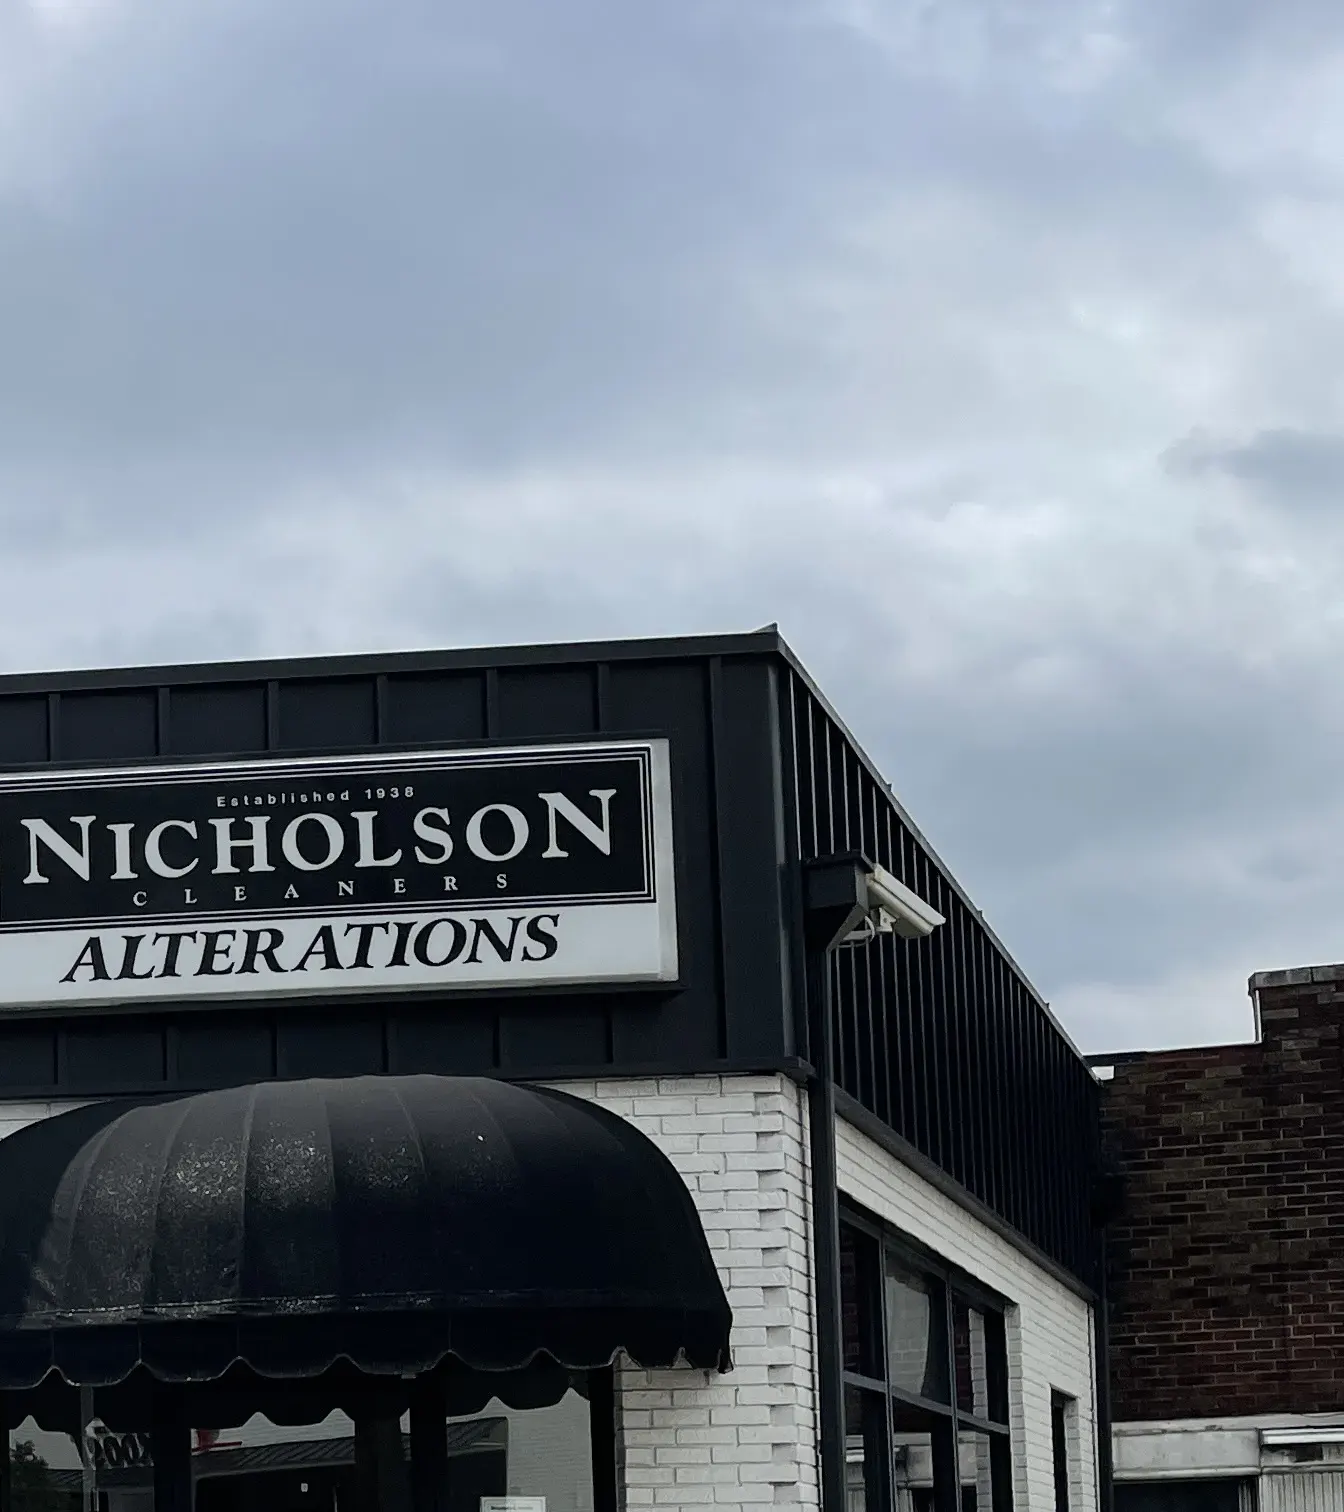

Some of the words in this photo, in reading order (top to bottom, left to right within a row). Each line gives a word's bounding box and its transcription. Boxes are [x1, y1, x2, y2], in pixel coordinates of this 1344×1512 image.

[216, 790, 350, 808] Established
[364, 786, 414, 800] 1938
[21, 788, 617, 885] NICHOLSON
[132, 871, 510, 907] CLEANERS
[59, 914, 561, 984] ALTERATIONS
